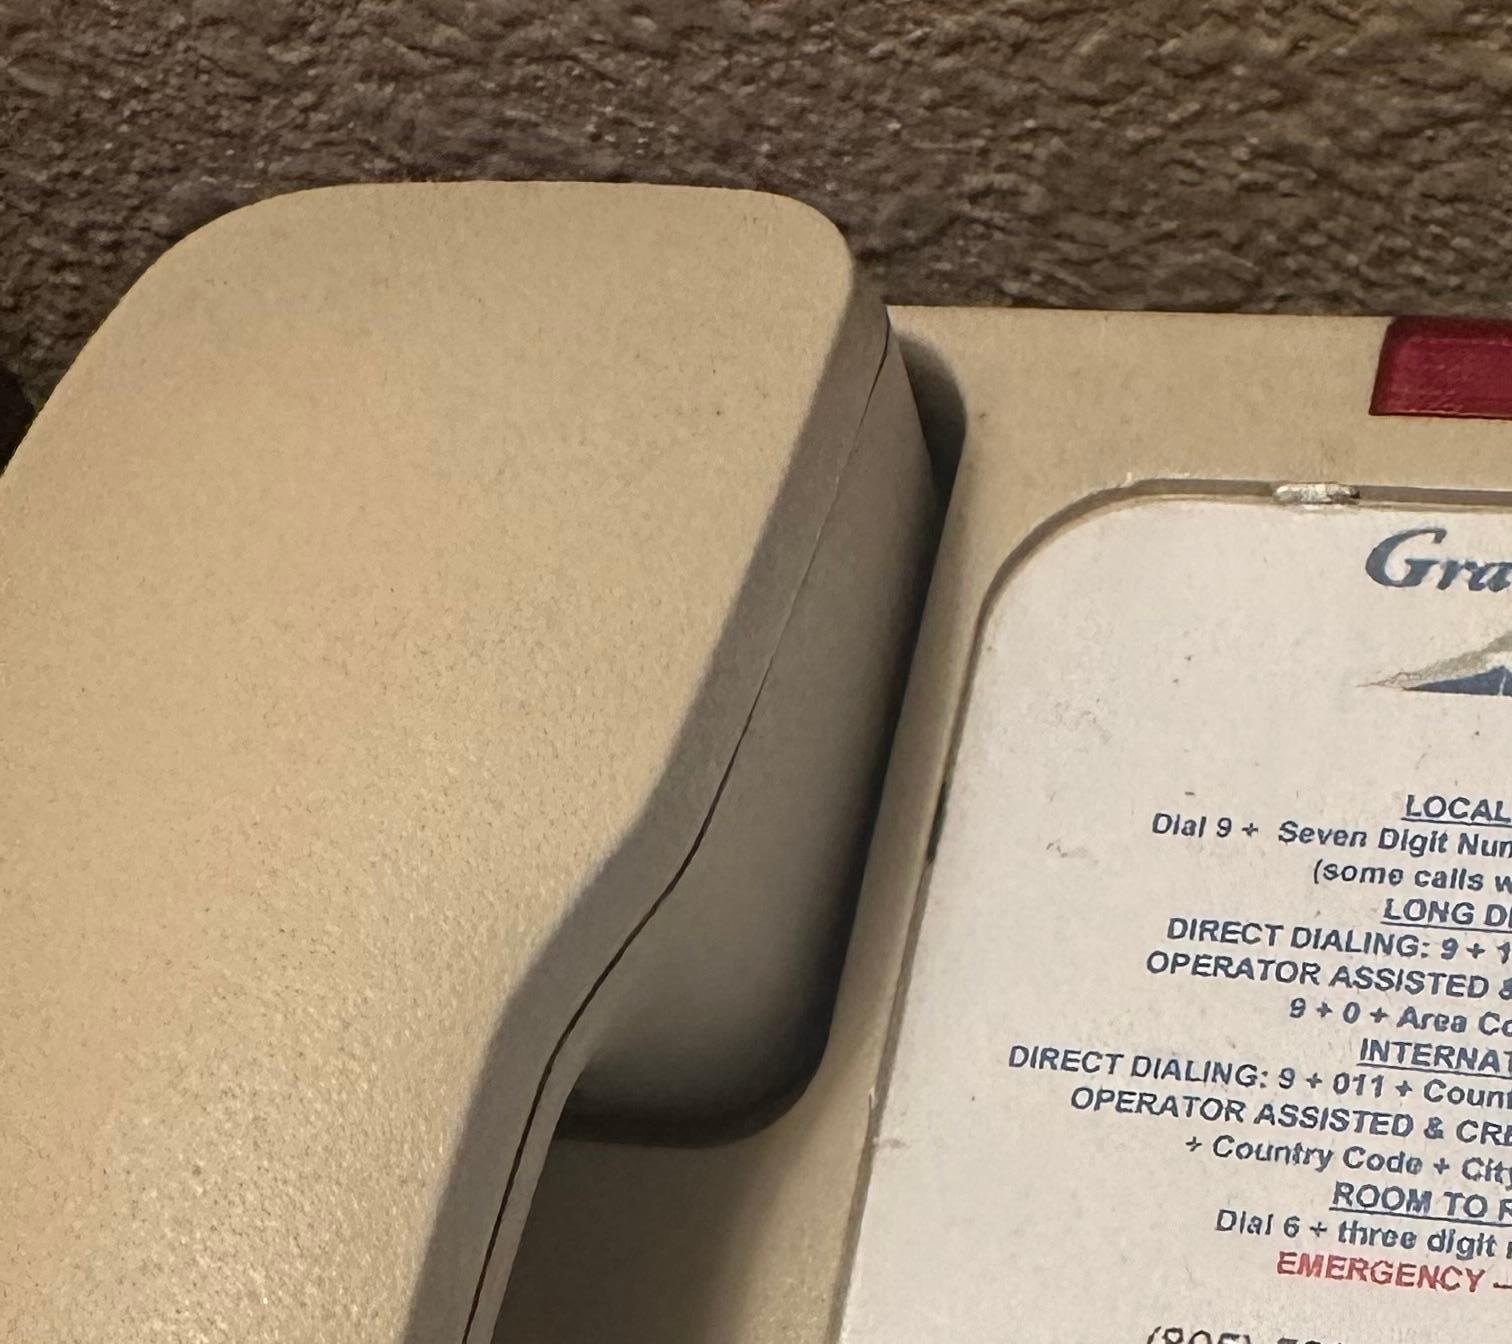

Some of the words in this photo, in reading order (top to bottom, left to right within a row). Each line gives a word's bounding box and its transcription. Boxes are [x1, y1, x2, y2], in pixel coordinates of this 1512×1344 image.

[1404, 795, 1511, 826] LOCAL
[1152, 813, 1206, 838] Dial
[1216, 817, 1233, 839] 9
[1241, 822, 1259, 839] +
[1279, 822, 1367, 849] Seven
[1378, 827, 1448, 857] Digit
[1313, 858, 1403, 886] (some
[1414, 867, 1484, 891] calls
[1382, 898, 1474, 927] LONG
[1167, 917, 1284, 948] DIRECT
[1291, 926, 1430, 959] DIALING:
[1440, 937, 1457, 960] 9
[1466, 943, 1485, 960] +
[1498, 942, 1510, 963] 1
[1146, 950, 1321, 986] OPERATOR
[1329, 966, 1490, 999] ASSISTED
[1289, 997, 1306, 1019] 9
[1316, 1001, 1333, 1019] +
[1342, 1001, 1360, 1024] 0
[1370, 1007, 1388, 1024] +
[1396, 1006, 1467, 1035] Area
[1009, 1044, 1123, 1076] DIRECT
[1130, 1055, 1268, 1089] DIALING:
[1278, 1068, 1295, 1090] 9
[1305, 1072, 1323, 1089] +
[1332, 1072, 1385, 1098] 011
[1394, 1081, 1413, 1098] +
[1070, 1086, 1246, 1122] OPERATOR
[1253, 1102, 1414, 1138] ASSISTED
[1423, 1117, 1444, 1140] &
[1185, 1136, 1203, 1153] +
[1213, 1135, 1333, 1171] Country
[1342, 1146, 1423, 1176] Code
[1432, 1158, 1450, 1175] +
[1329, 1181, 1433, 1214] ROOM
[1442, 1191, 1488, 1219] TO
[1215, 1208, 1273, 1237] Dial
[1283, 1214, 1300, 1237] 6
[1309, 1221, 1328, 1238] +
[1338, 1219, 1417, 1250] three
[1426, 1226, 1498, 1259] digit
[1277, 1252, 1485, 1292] EMERGENCY
